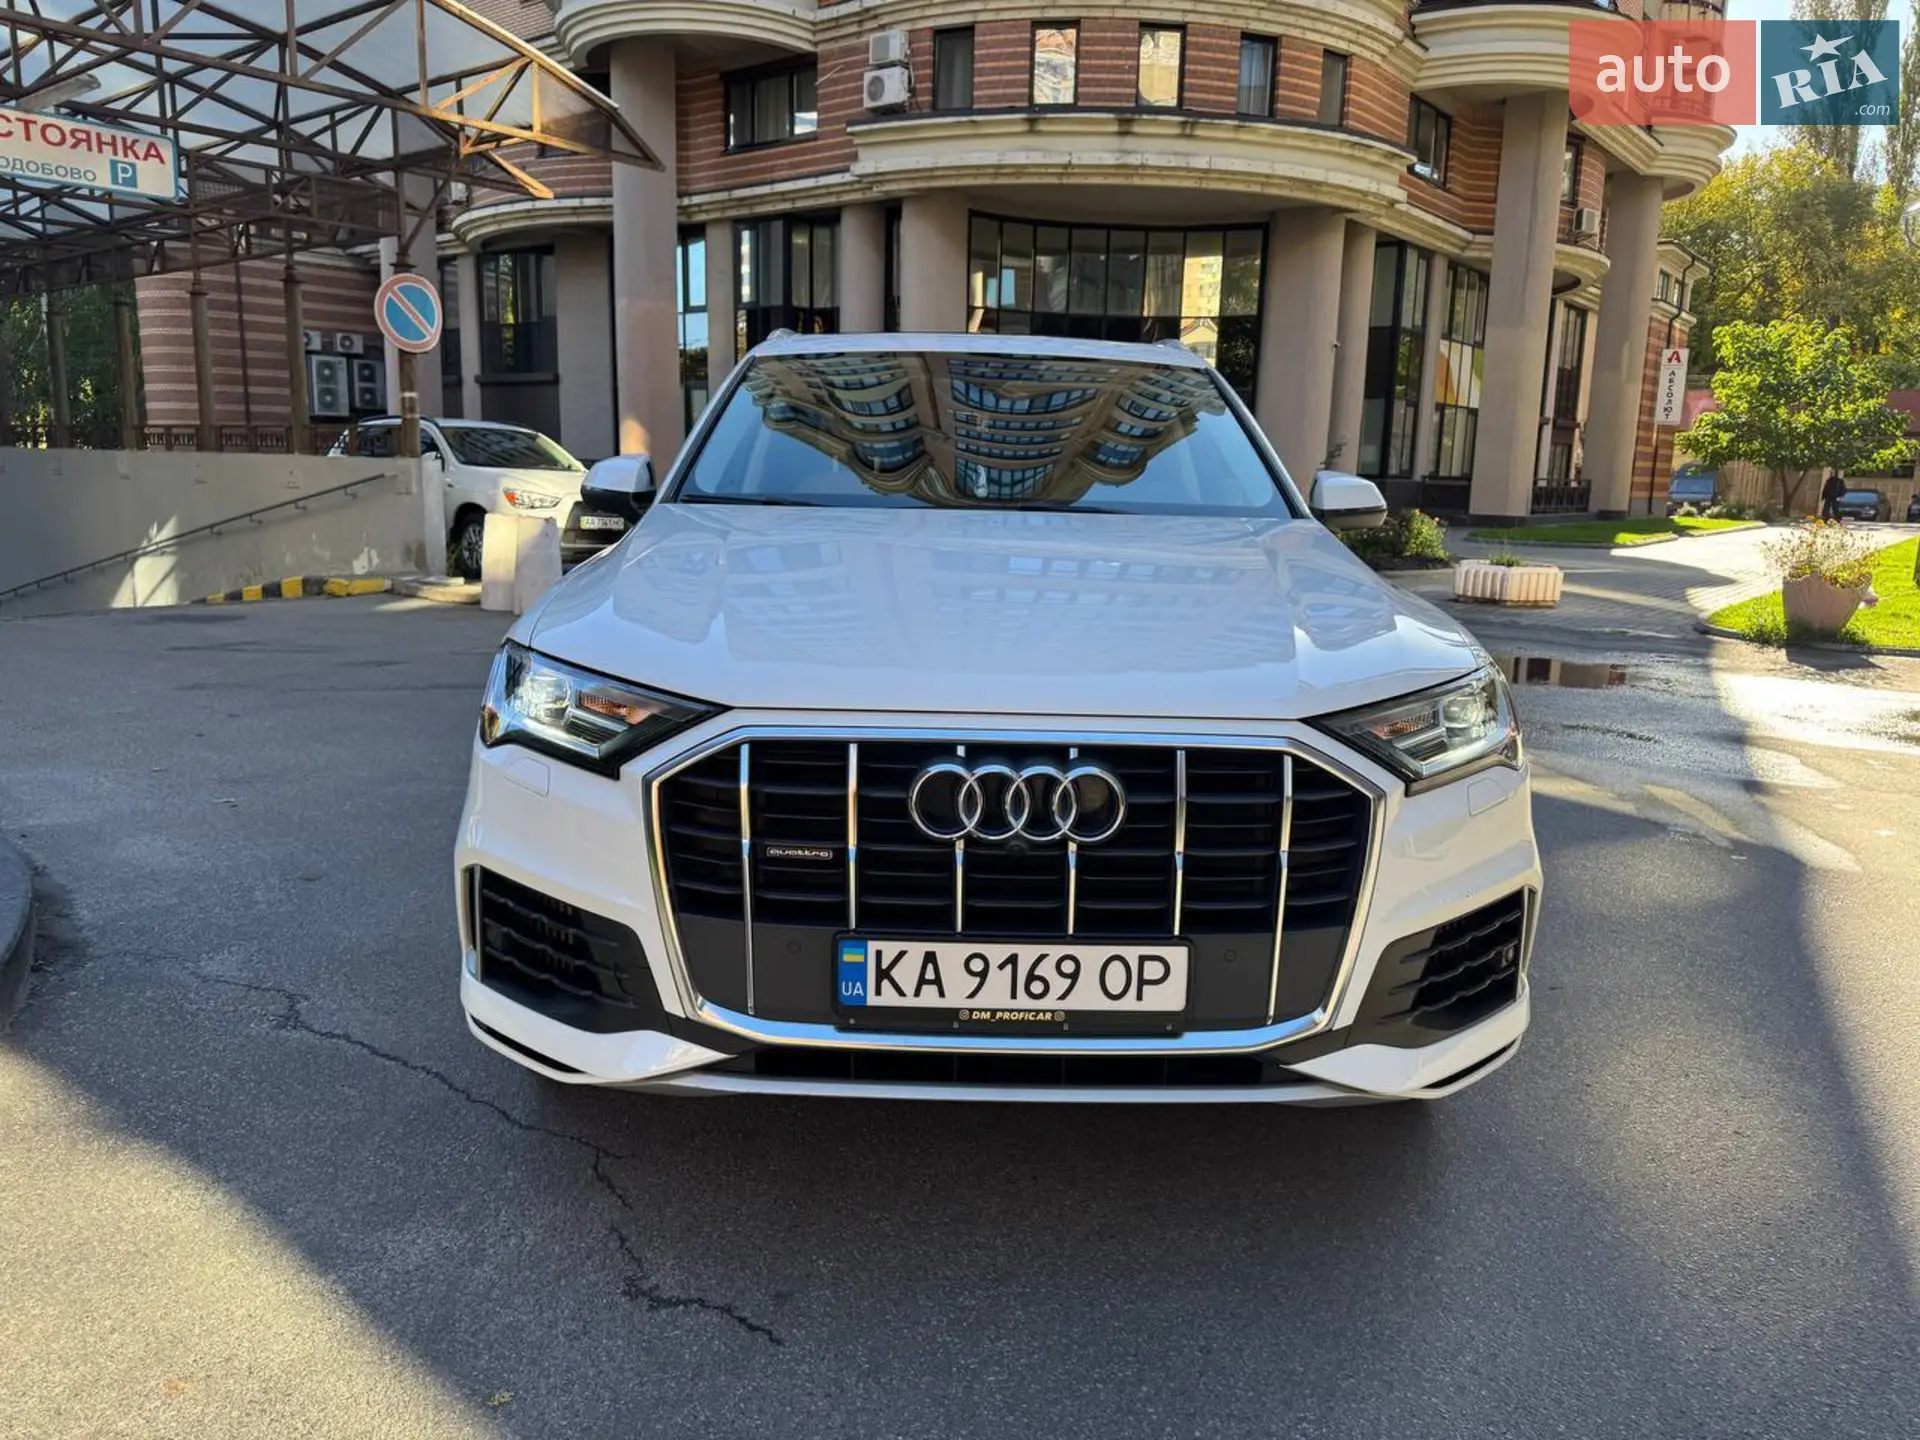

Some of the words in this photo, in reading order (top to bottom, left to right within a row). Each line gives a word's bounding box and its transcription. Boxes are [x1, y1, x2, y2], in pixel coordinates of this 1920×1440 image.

[117, 162, 133, 185] P
[769, 847, 829, 858] quattro
[874, 949, 946, 999] KA
[963, 951, 1082, 1001] 9169
[1099, 953, 1171, 1002] OP
[842, 981, 864, 996] UA
[972, 1010, 1053, 1023] DM_PROFICAR
